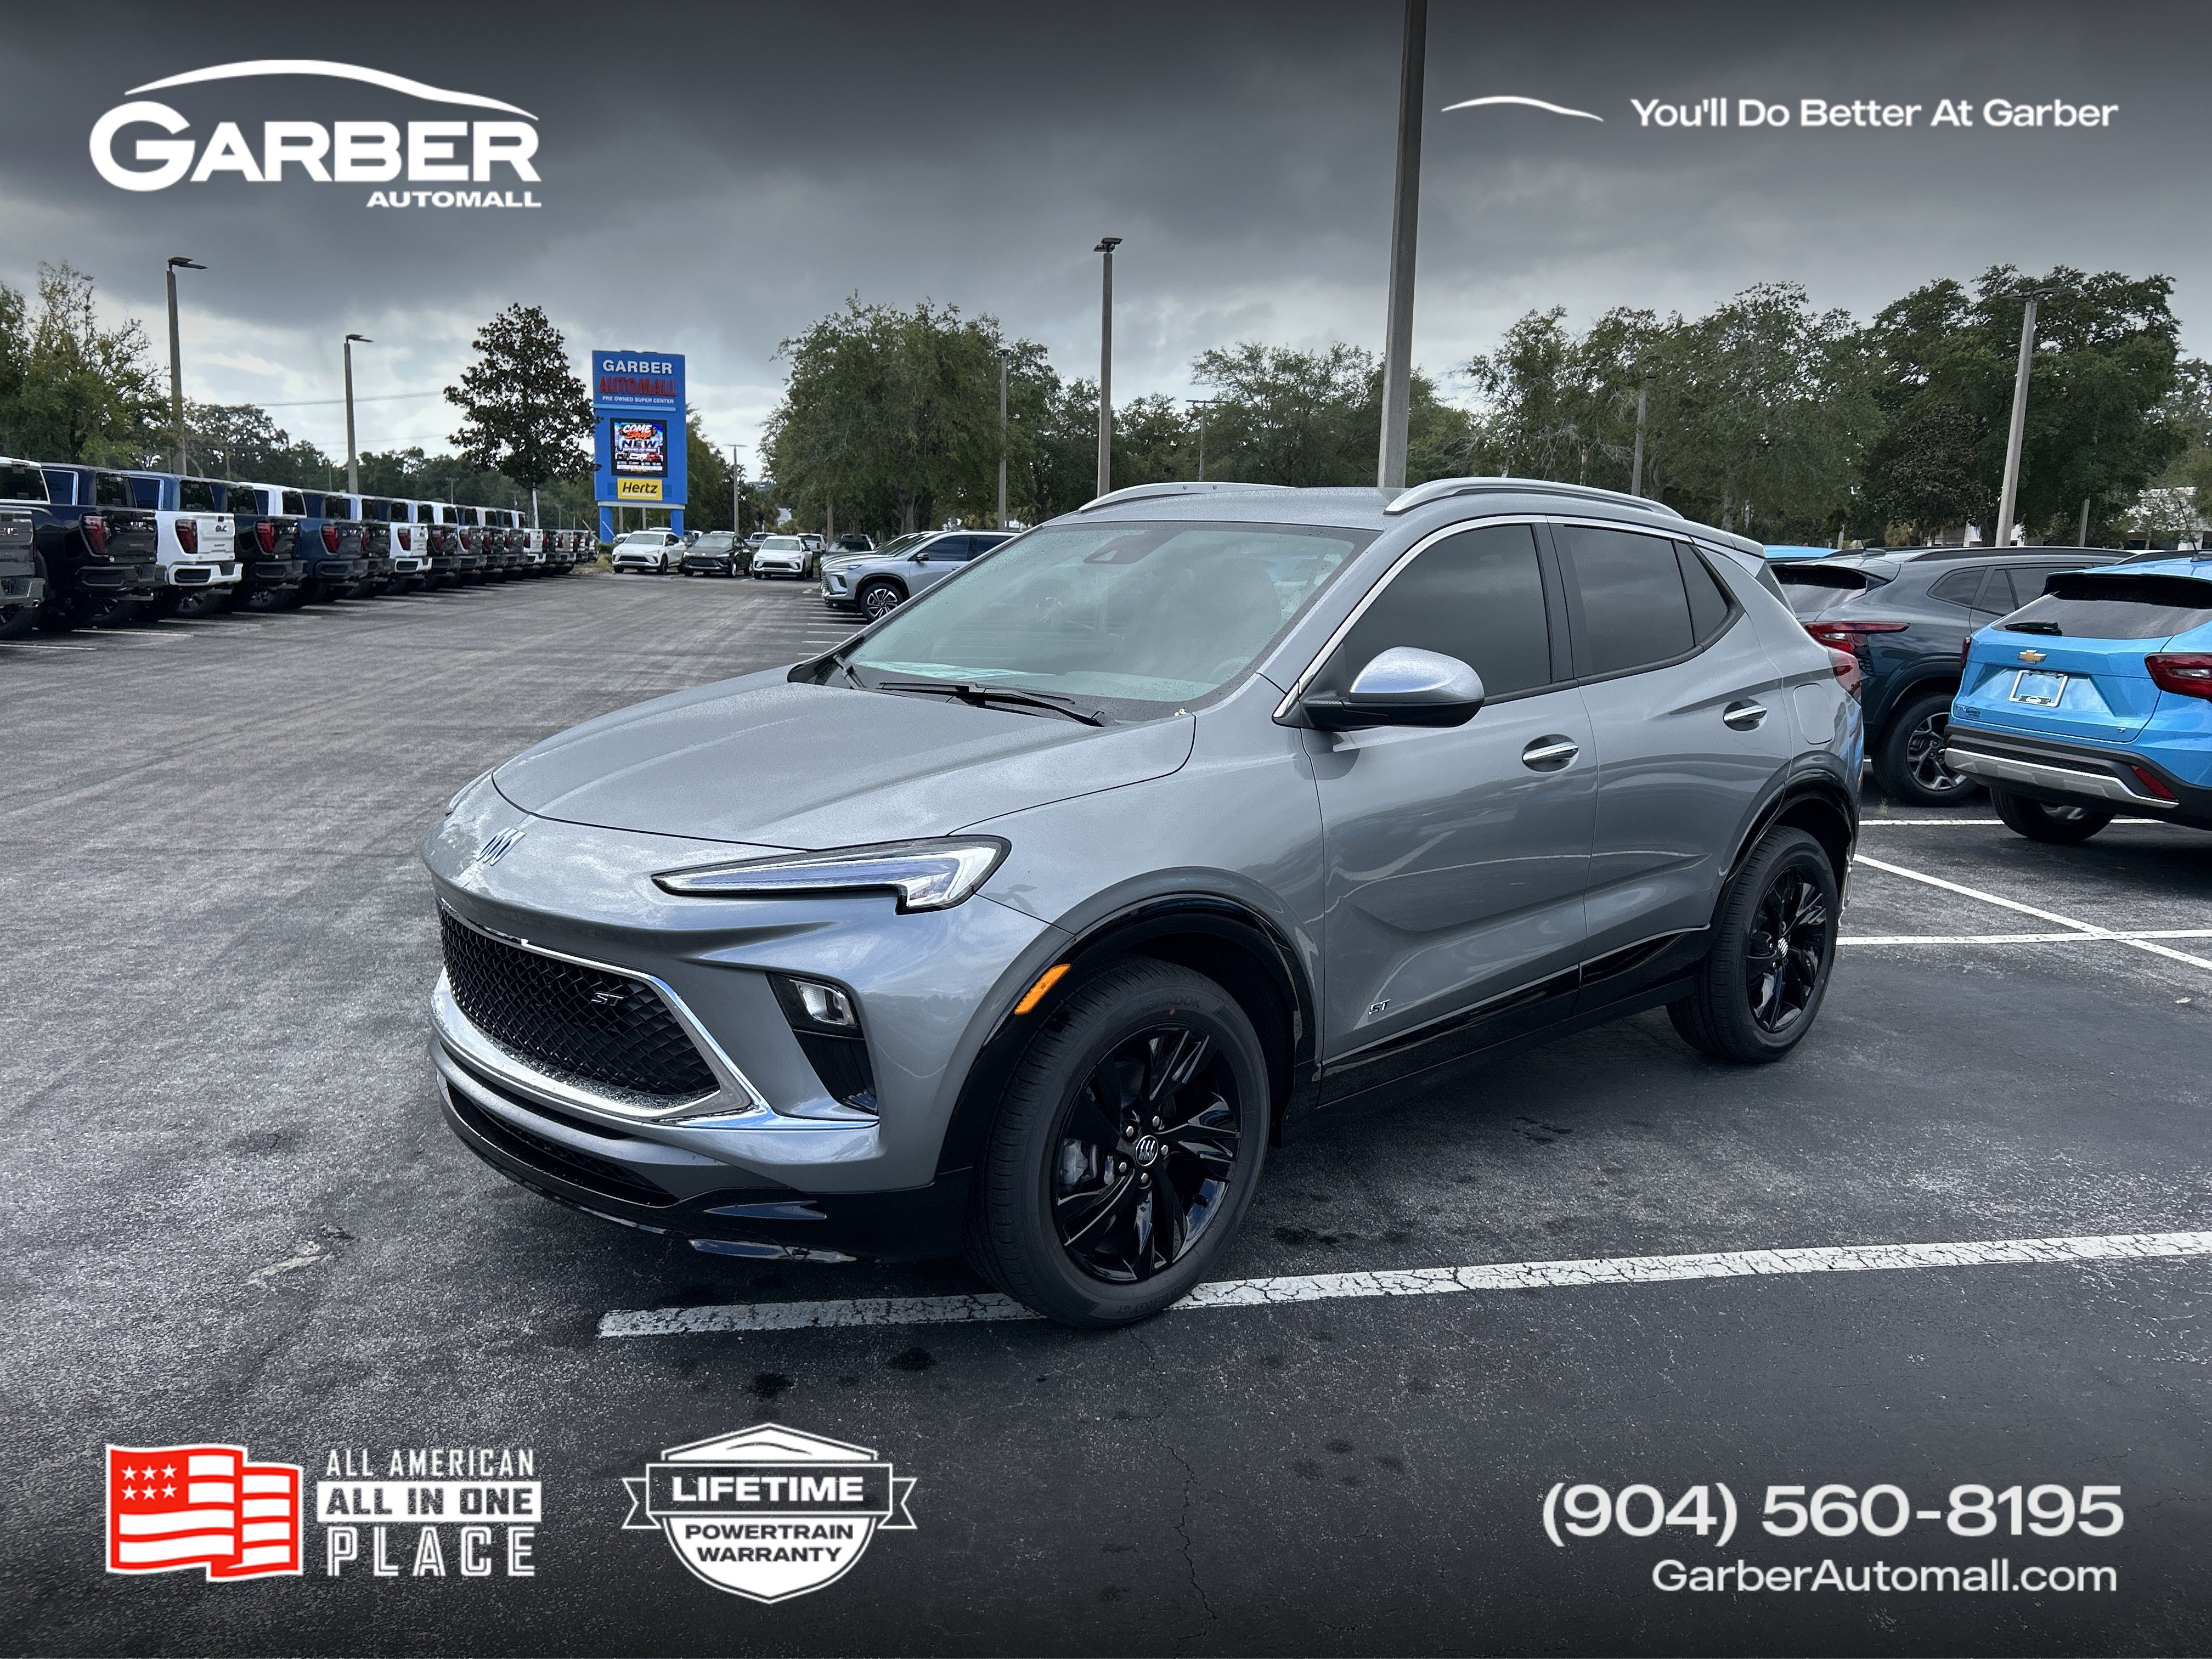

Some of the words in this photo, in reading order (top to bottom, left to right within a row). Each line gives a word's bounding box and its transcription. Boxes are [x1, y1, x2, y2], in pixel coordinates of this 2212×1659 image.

[602, 359, 673, 375] GARBER
[599, 375, 676, 396] AUTOMALL
[622, 424, 653, 433] COME
[622, 439, 657, 449] NEW
[622, 481, 658, 494] Hertz
[591, 990, 625, 1007] ST
[1368, 998, 1391, 1015] ST
